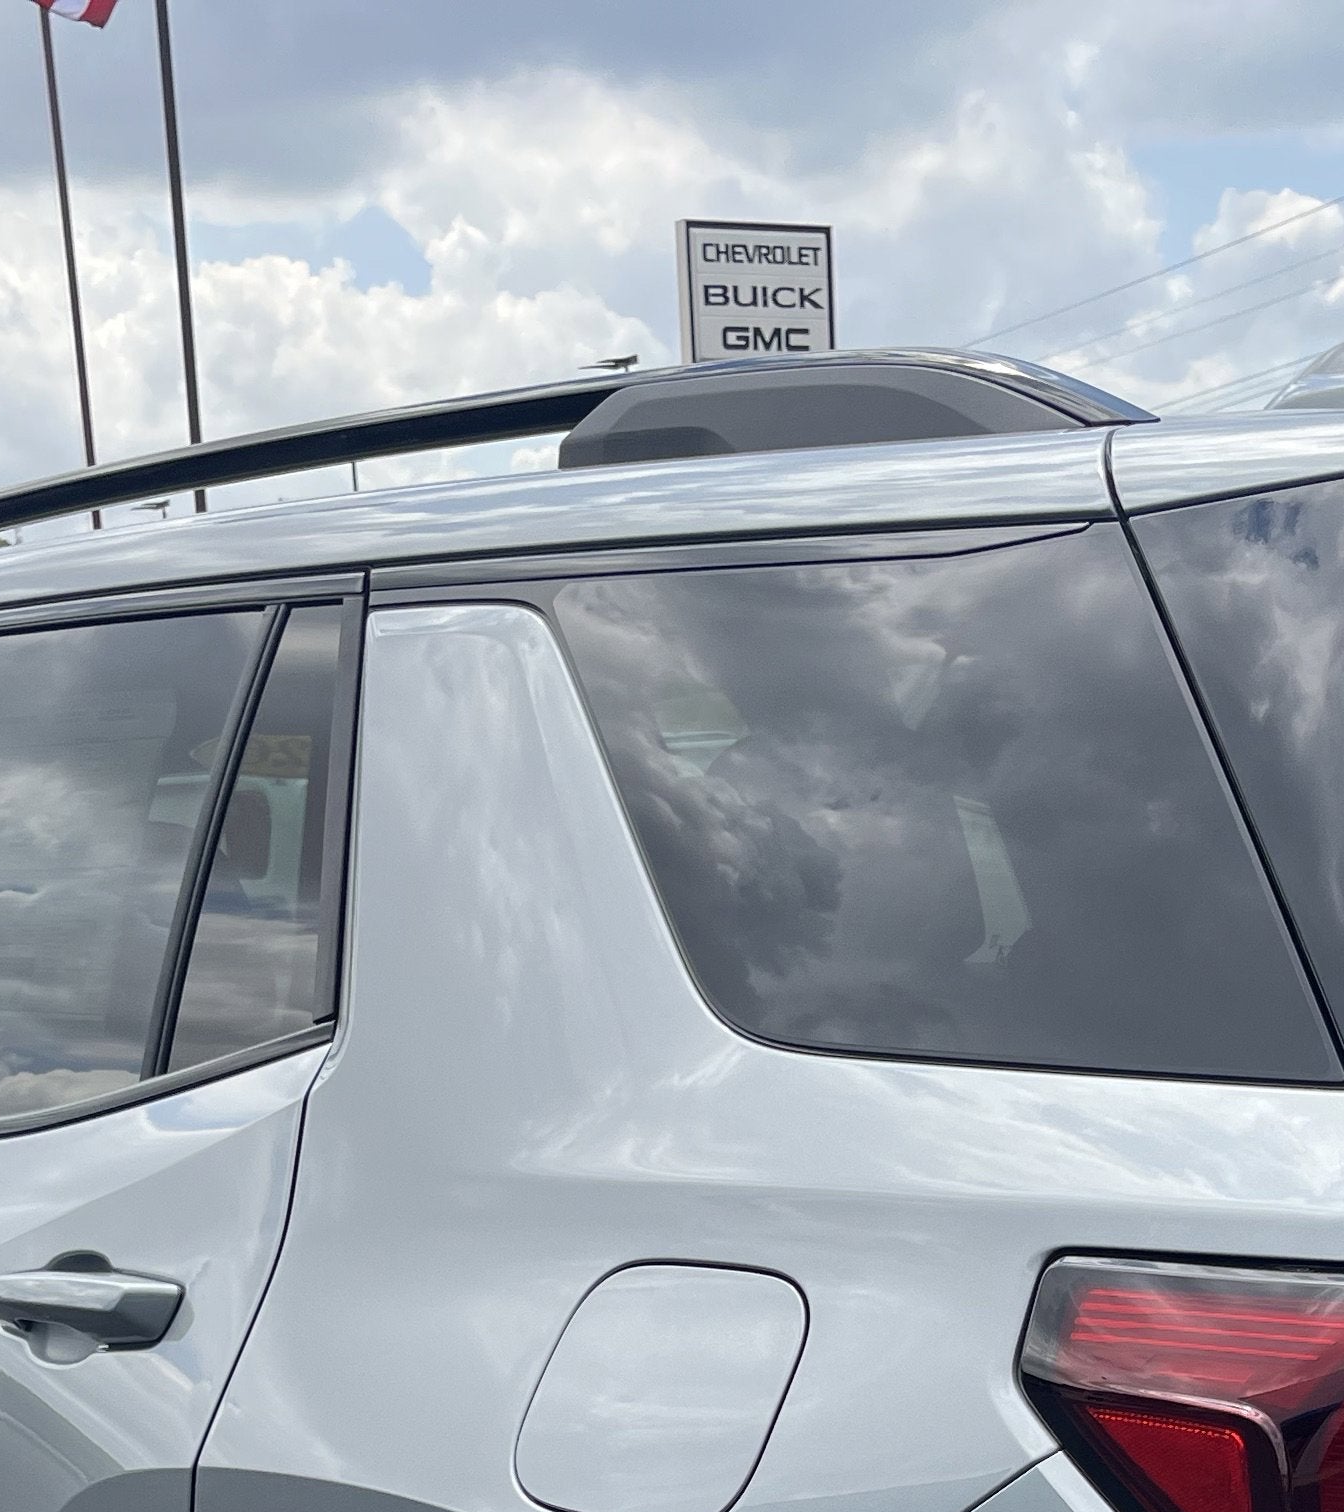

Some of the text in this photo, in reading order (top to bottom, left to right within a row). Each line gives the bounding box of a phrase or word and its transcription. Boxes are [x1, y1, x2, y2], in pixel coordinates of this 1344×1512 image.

[702, 243, 821, 266] CHEVROLET
[703, 284, 825, 310] BUICK
[722, 326, 810, 351] GMC
